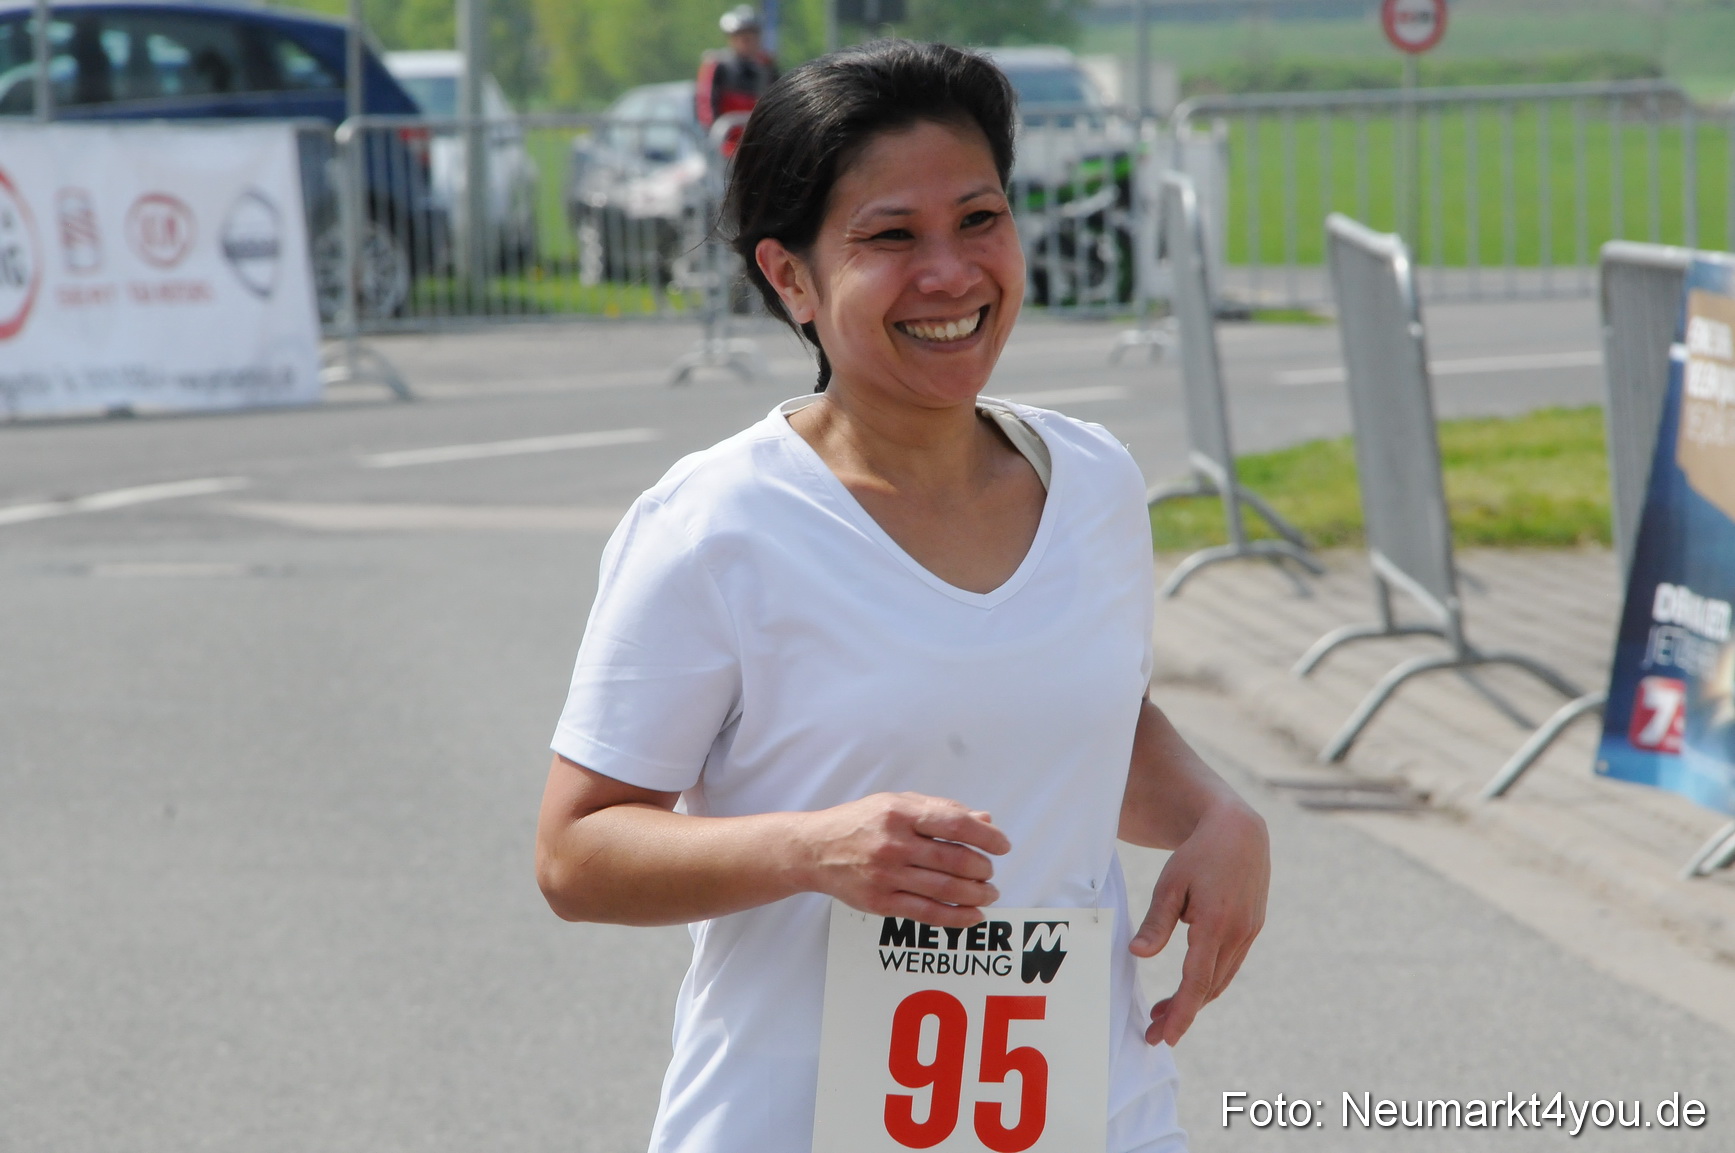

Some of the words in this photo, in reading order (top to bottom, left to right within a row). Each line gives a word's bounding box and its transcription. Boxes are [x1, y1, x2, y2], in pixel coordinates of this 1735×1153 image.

[879, 916, 1013, 951] MEYER
[879, 949, 1013, 976] WERBUNG
[884, 989, 1049, 1153] 95
